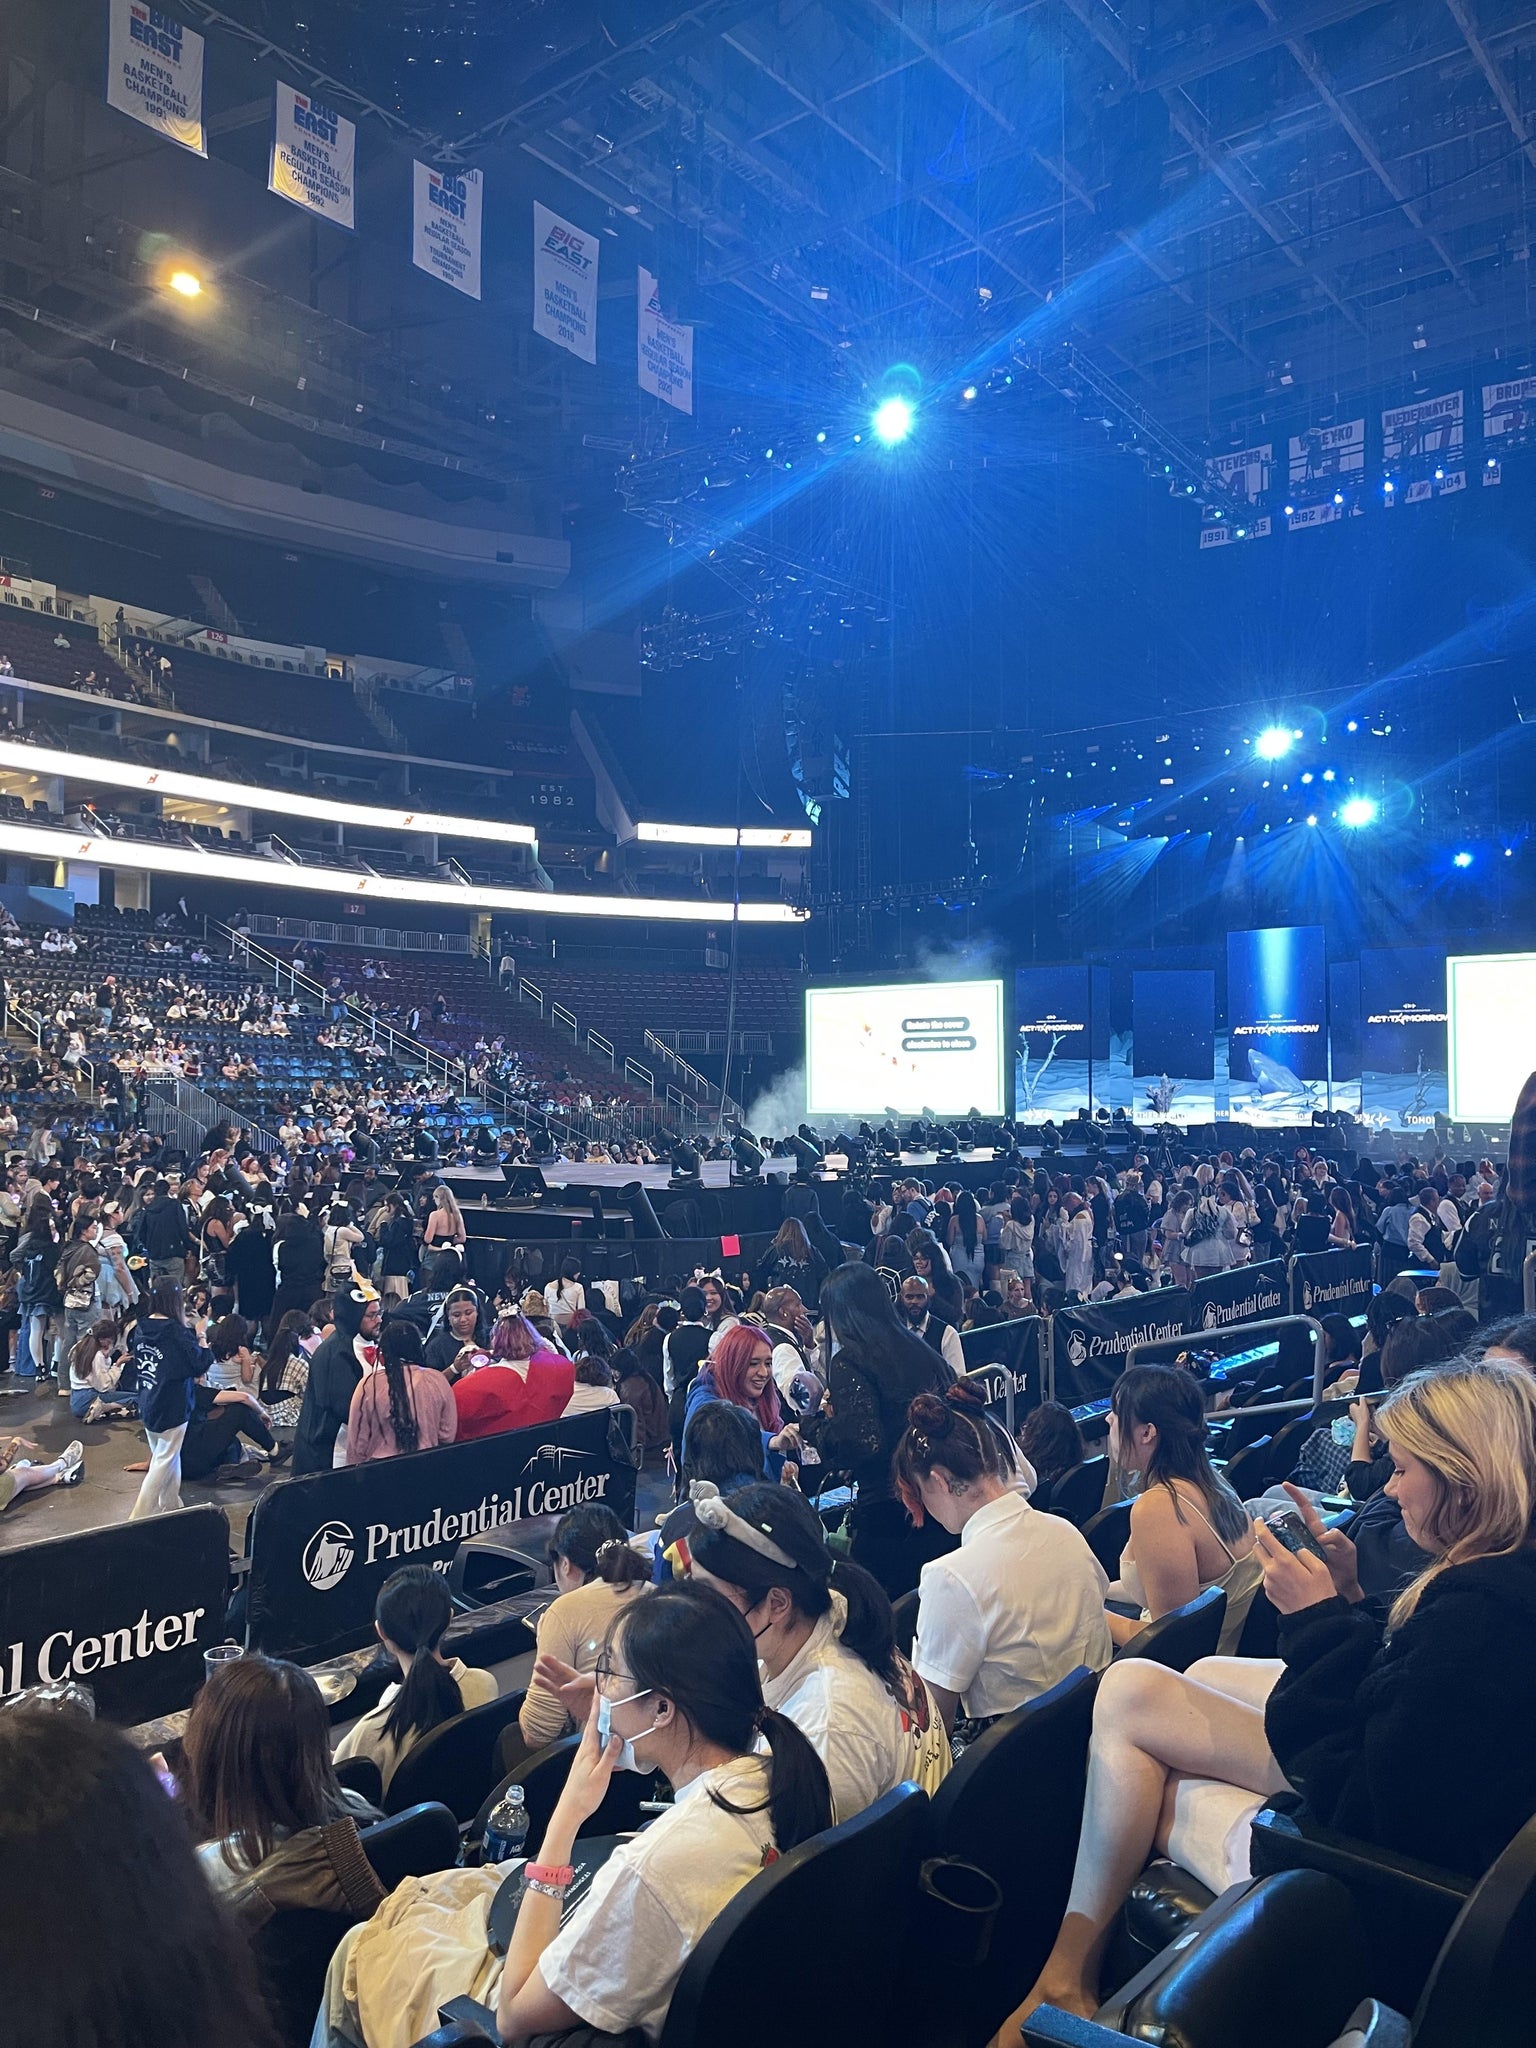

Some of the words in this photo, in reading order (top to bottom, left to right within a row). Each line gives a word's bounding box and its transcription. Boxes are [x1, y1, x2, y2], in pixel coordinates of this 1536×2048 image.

[130, 15, 183, 63] EAST
[123, 62, 188, 106] BASKETBALL
[140, 58, 172, 84] MEN'S
[125, 78, 186, 118] CHAMPIONS
[294, 104, 338, 145] EAST
[291, 144, 341, 181] BASKETBALL
[304, 140, 329, 162] MEN'S
[280, 151, 318, 180] REGULAR
[320, 172, 351, 197] SEASON
[292, 170, 339, 204] CHAMPIONS
[429, 182, 466, 220] EAST
[544, 236, 593, 270] EAST
[550, 225, 585, 252] BIG
[544, 288, 588, 323] BASKETBALL
[555, 280, 578, 303] MEN'S
[545, 303, 587, 336] CHAMPIONS
[530, 795, 575, 806] 1982
[1217, 1294, 1257, 1325] Prudential
[1258, 1289, 1280, 1311] Center
[1313, 1280, 1349, 1303] Prudential
[1089, 1324, 1148, 1357] Prudential
[1149, 1319, 1183, 1342] Center
[363, 1486, 522, 1566] Prudential
[528, 1470, 611, 1517] Center
[37, 1607, 205, 1684] Center
